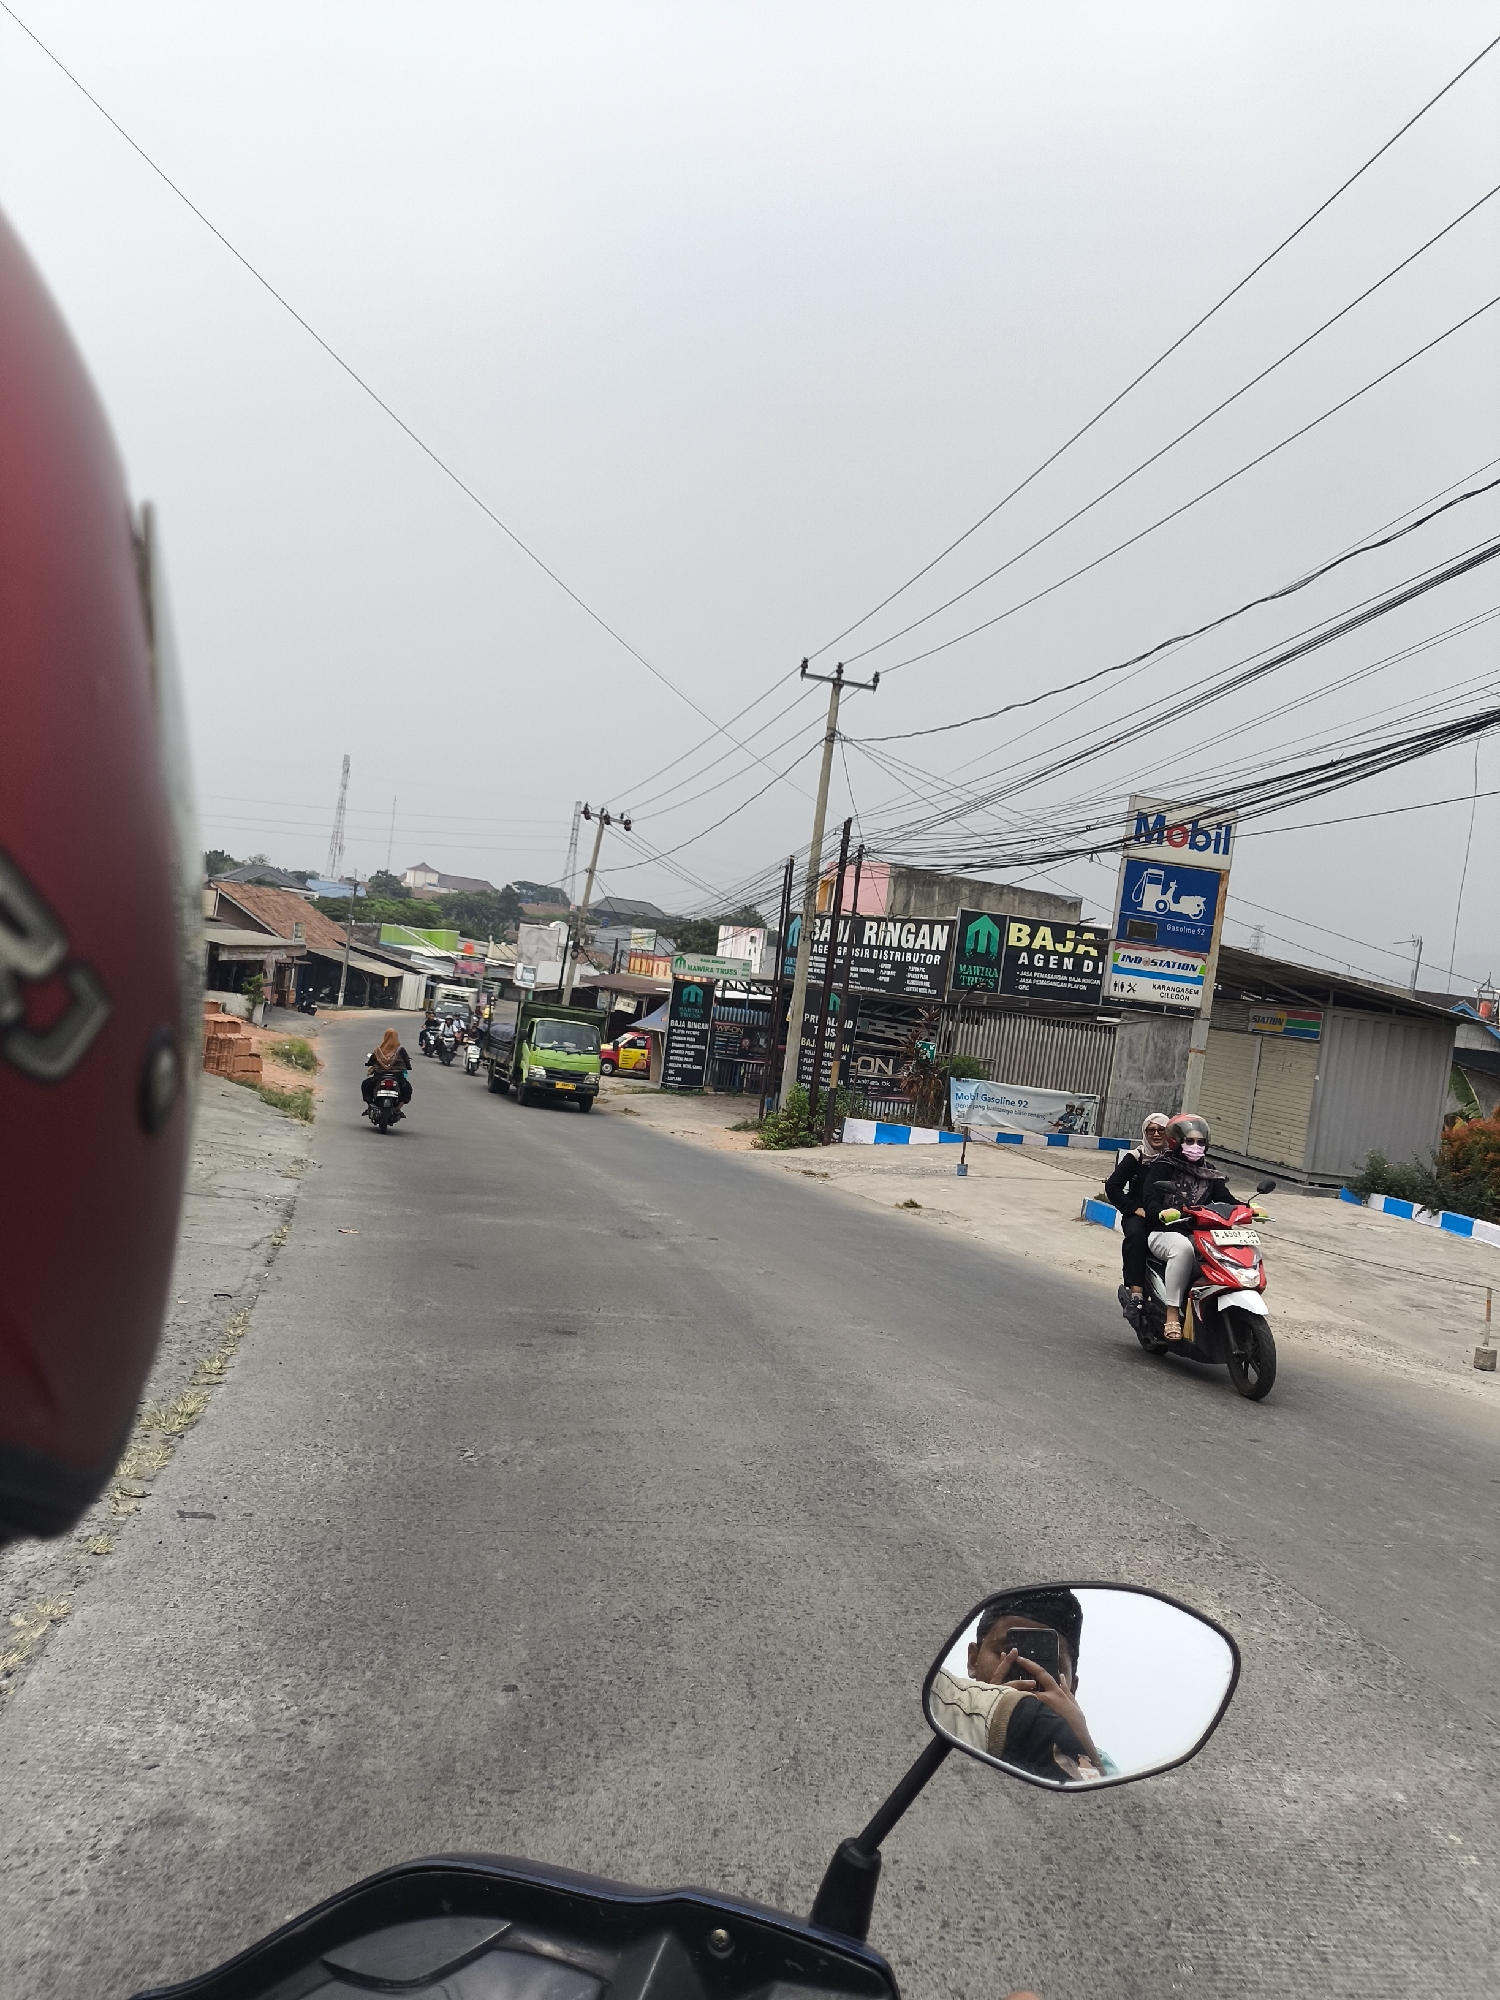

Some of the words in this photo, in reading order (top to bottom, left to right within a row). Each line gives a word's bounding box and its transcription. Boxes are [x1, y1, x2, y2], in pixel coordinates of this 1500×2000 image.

[1134, 811, 1232, 855] Mobil
[863, 920, 949, 951] RINGAN
[1007, 922, 1099, 957] BAJA
[873, 949, 942, 965] DISTRIBUTOR
[1018, 952, 1074, 971] AGEN
[716, 967, 738, 976] TRUSS
[957, 963, 999, 979] MAWIRA
[1152, 982, 1200, 996] KARANGASEM
[1159, 992, 1190, 1002] CILEGON
[1251, 1014, 1285, 1026] STATION
[980, 1094, 1016, 1107] Gasoline
[1017, 1099, 1029, 1109] 92
